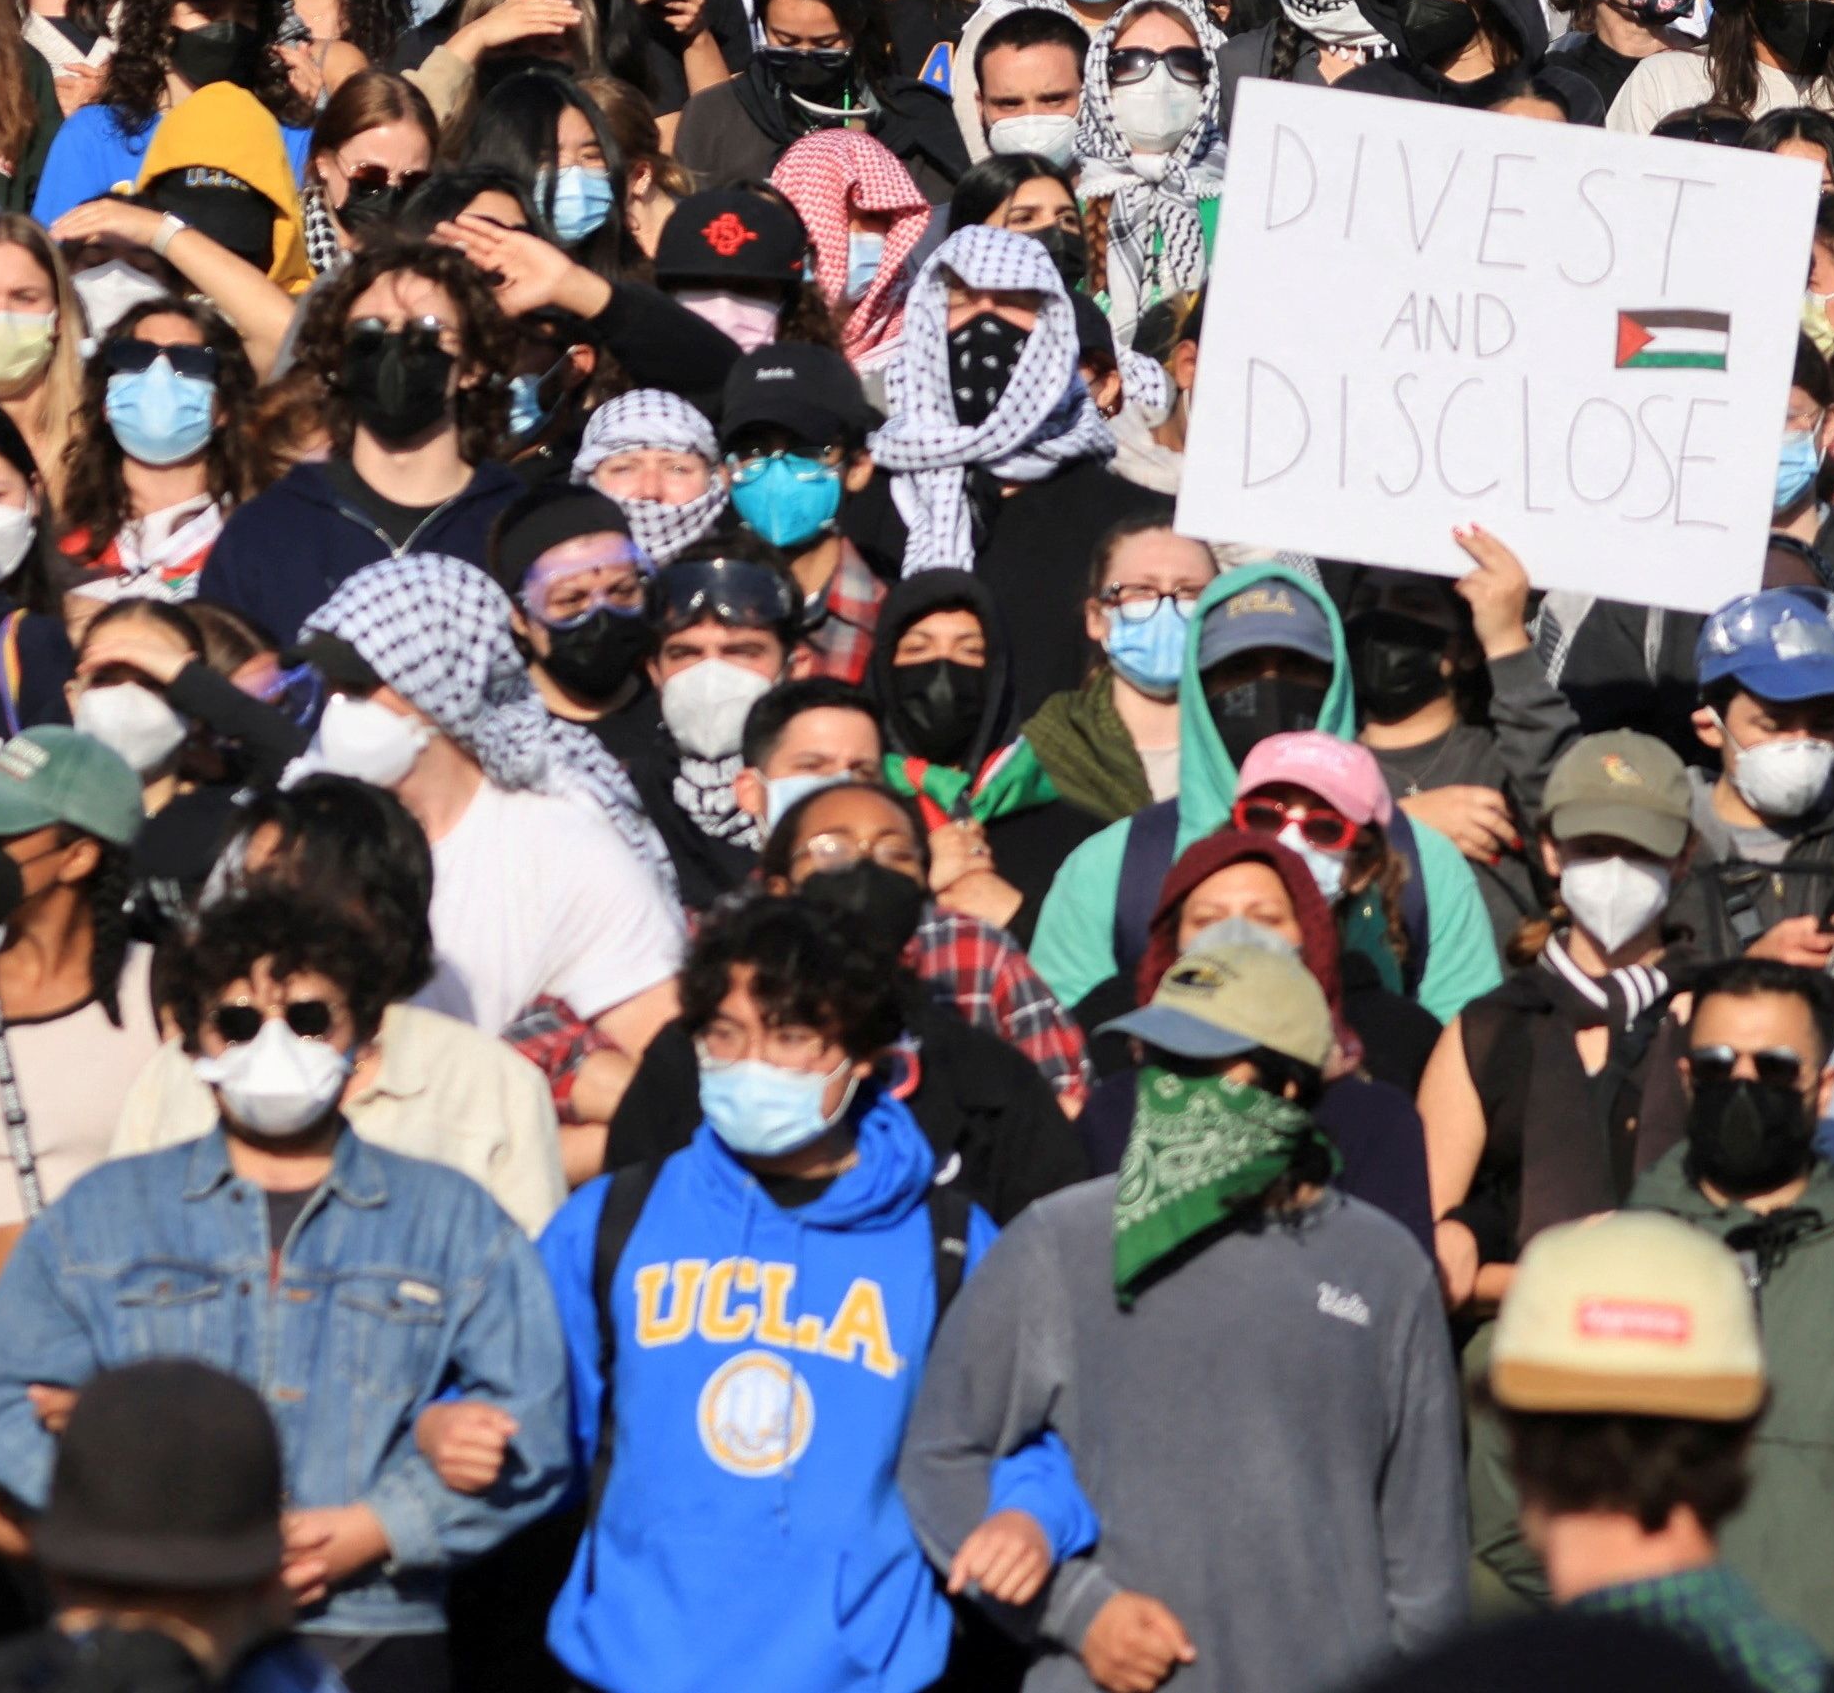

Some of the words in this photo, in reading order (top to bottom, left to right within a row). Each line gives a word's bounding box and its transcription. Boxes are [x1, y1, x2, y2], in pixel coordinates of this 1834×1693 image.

[1265, 123, 1717, 295] DIVEST
[1380, 291, 1516, 358] AND
[1242, 356, 1729, 530] DISCLOSE
[634, 1256, 900, 1380] UCLA
